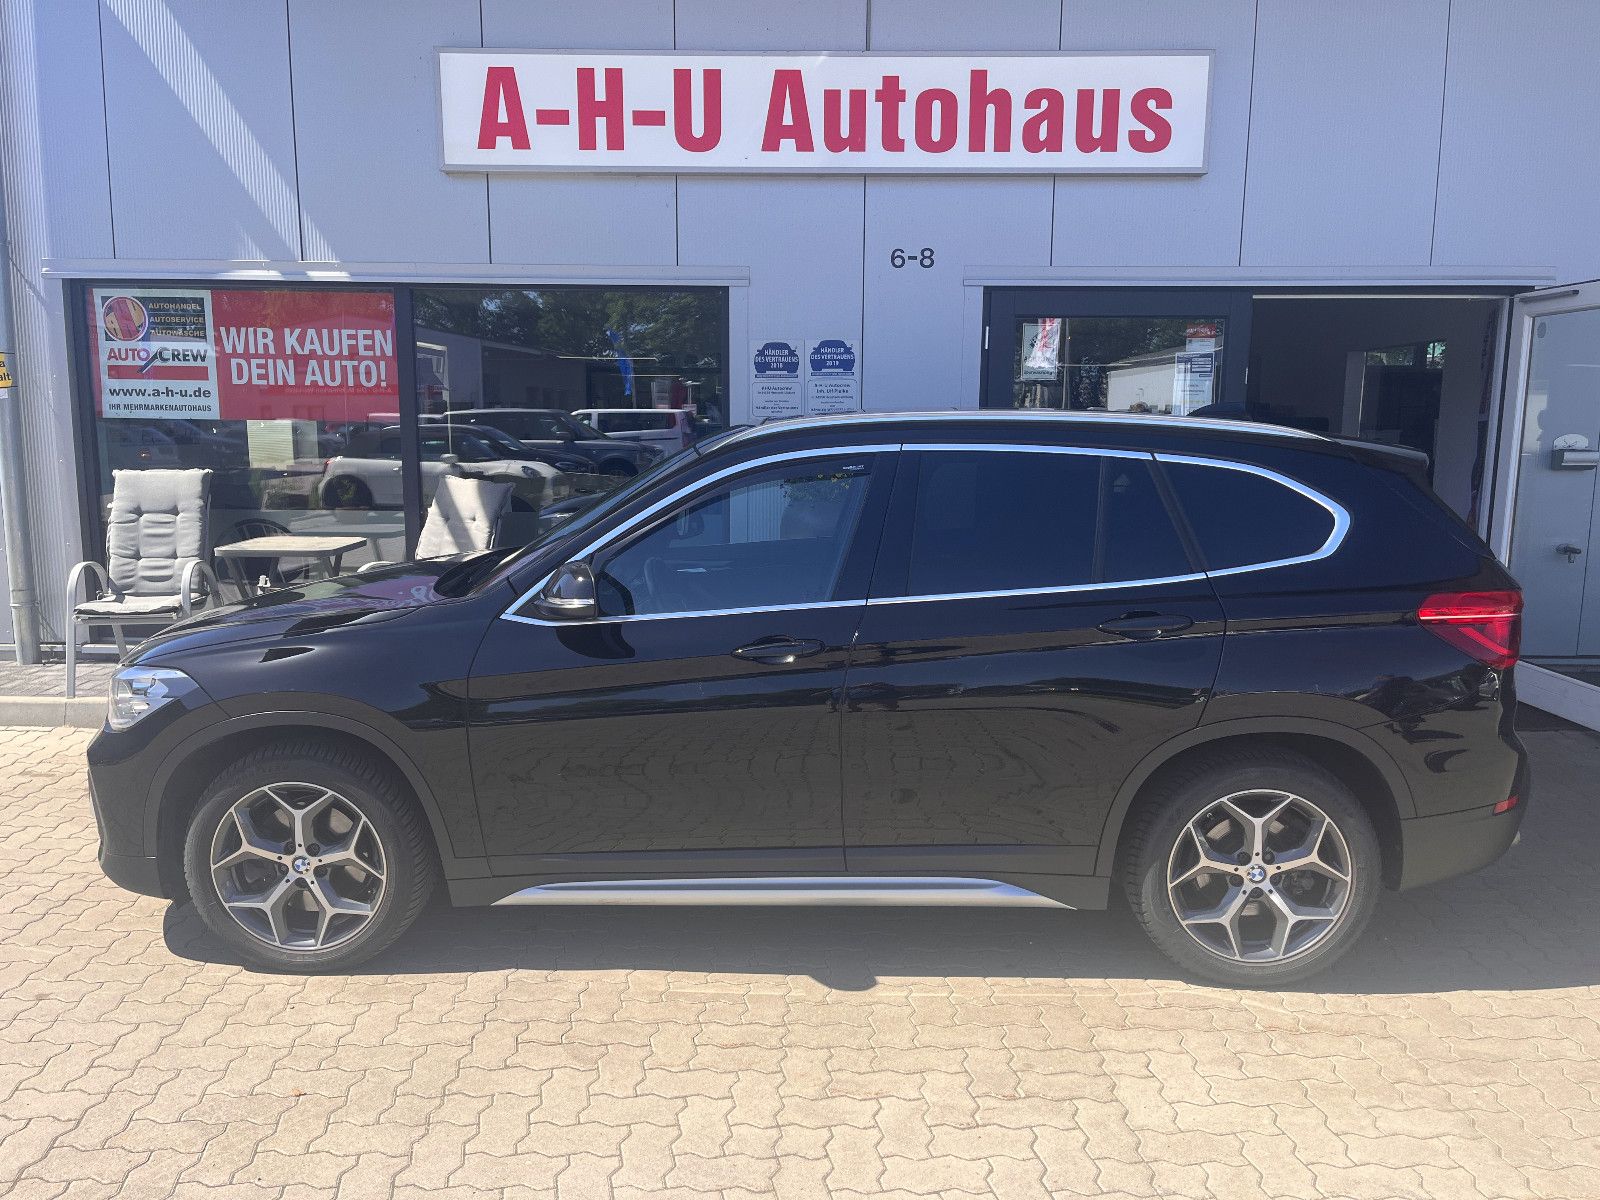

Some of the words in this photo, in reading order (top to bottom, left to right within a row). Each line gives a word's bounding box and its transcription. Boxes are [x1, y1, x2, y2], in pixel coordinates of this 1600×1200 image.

[477, 66, 722, 152] A-H-U
[760, 69, 1173, 153] Autohaus
[890, 247, 935, 269] 6-8
[148, 302, 202, 310] AUTOHANDEL
[219, 326, 275, 354] WIR
[283, 328, 393, 357] KAUFEN
[230, 358, 296, 386] DEIN
[304, 360, 387, 388] AUTO!
[109, 386, 212, 398] www.a-h-u.de
[109, 403, 120, 411] IHR
[123, 403, 212, 412] MEHRMARKENAUTOHAUS
